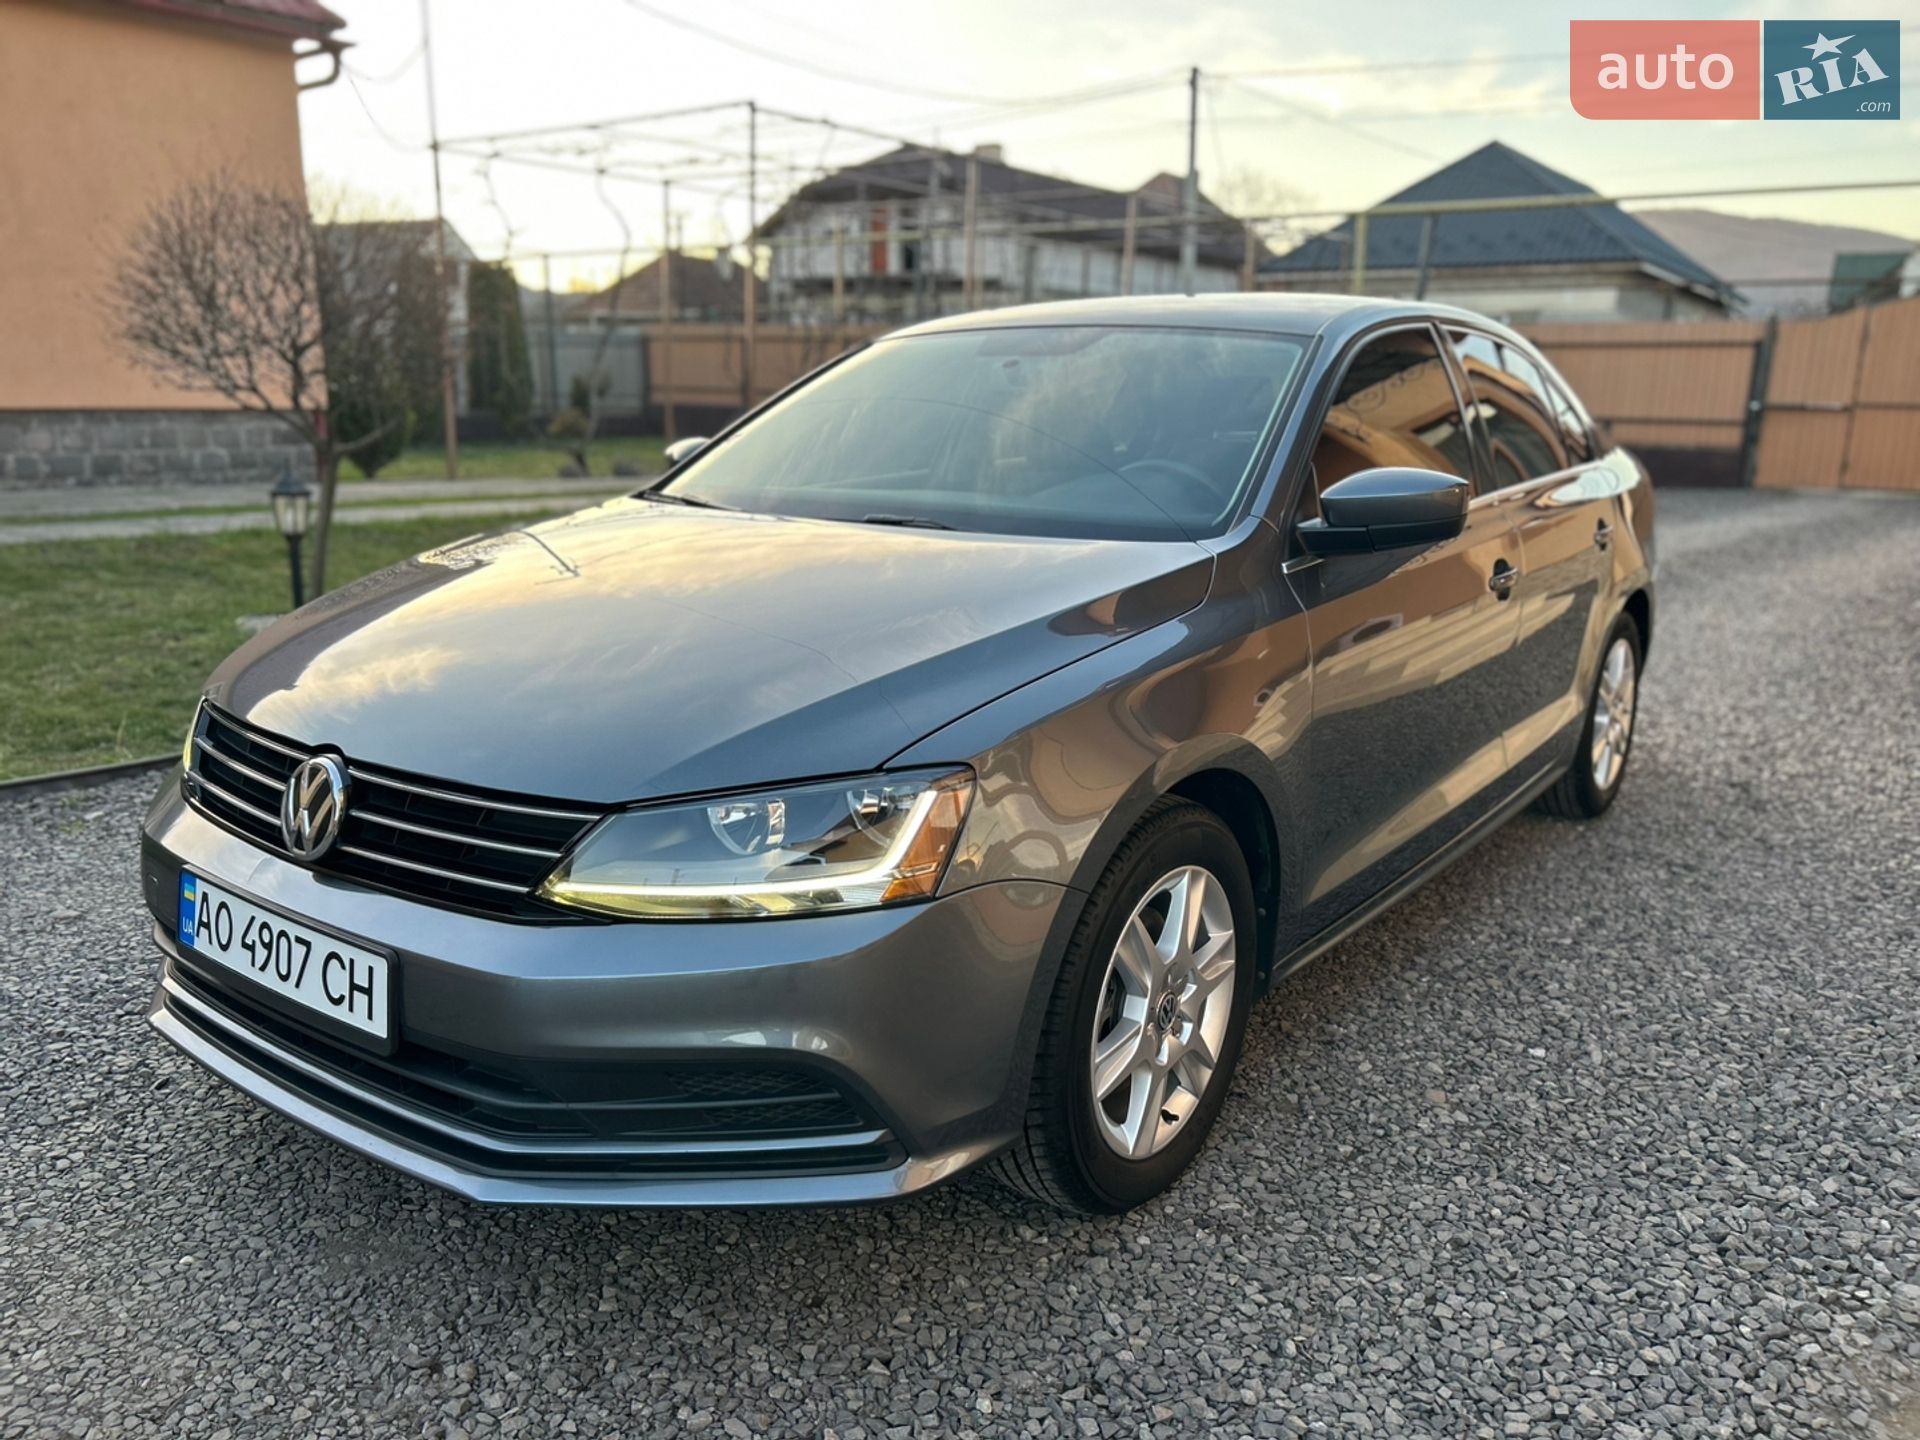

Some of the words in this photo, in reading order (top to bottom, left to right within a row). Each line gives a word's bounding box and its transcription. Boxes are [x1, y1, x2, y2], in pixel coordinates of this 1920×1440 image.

[182, 916, 194, 936] UA
[195, 890, 234, 953] AO
[240, 914, 312, 989] 4907
[321, 950, 374, 1021] CH
